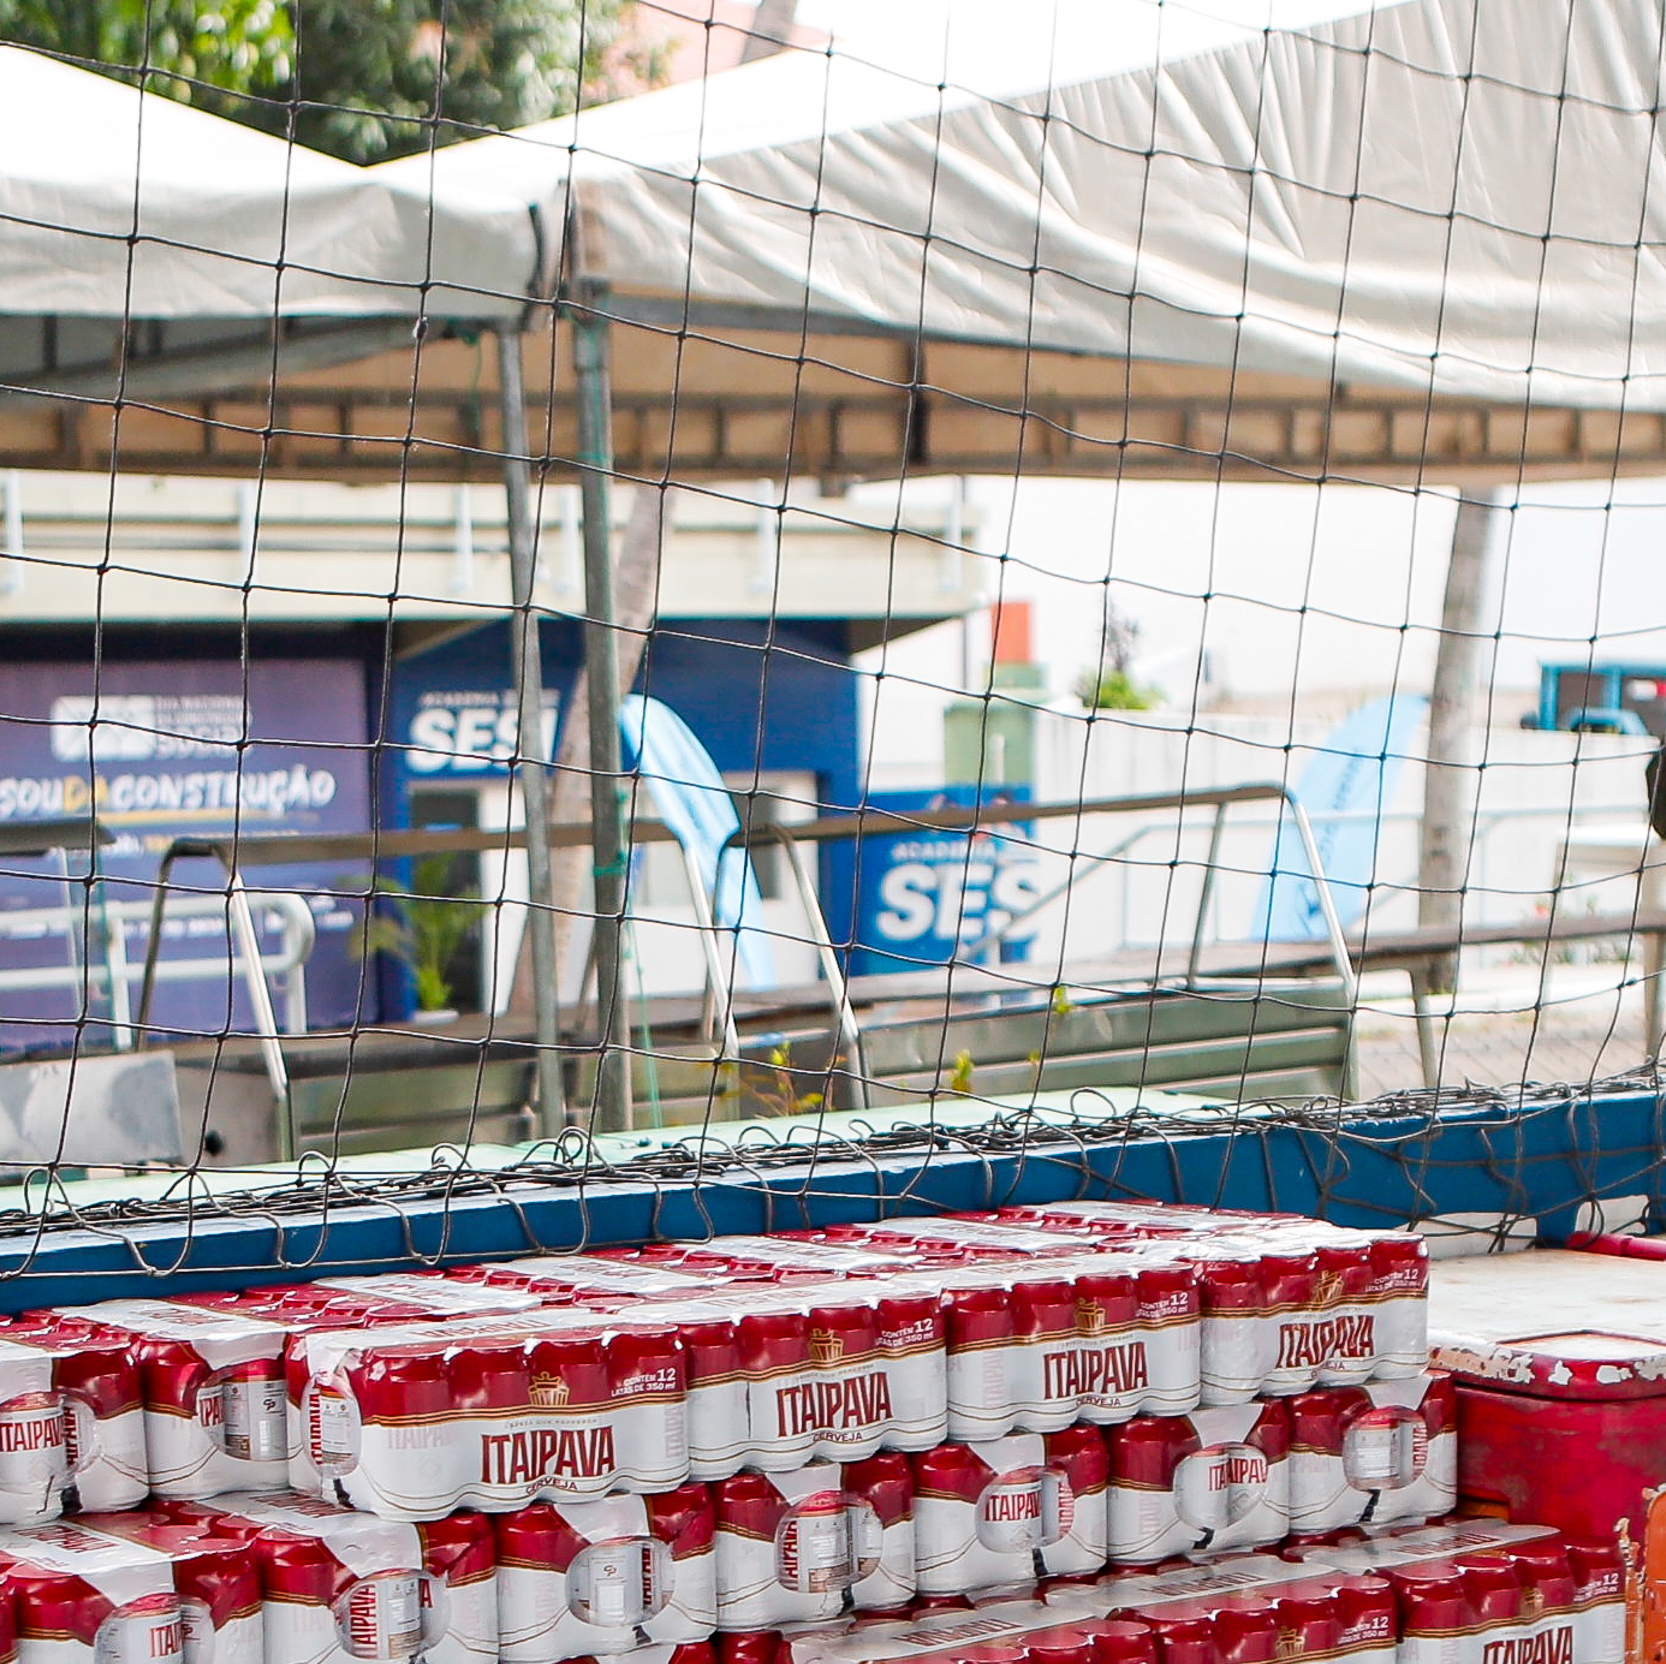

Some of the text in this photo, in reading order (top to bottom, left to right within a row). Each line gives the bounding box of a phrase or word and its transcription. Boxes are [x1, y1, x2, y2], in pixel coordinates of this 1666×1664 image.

[1403, 1268, 1419, 1280] 12
[1170, 1293, 1188, 1306] 12
[914, 1318, 933, 1333] 12
[1276, 1315, 1374, 1368] ITAIPAVA
[656, 1368, 676, 1382] 12
[1043, 1342, 1149, 1400] ITAIPAVA
[776, 1372, 893, 1437] ITAIPAVA
[480, 1425, 616, 1484] ITAIPAVA
[525, 1478, 577, 1495] CERVEJA
[1602, 1573, 1619, 1587] 12
[1371, 1616, 1389, 1630] 12
